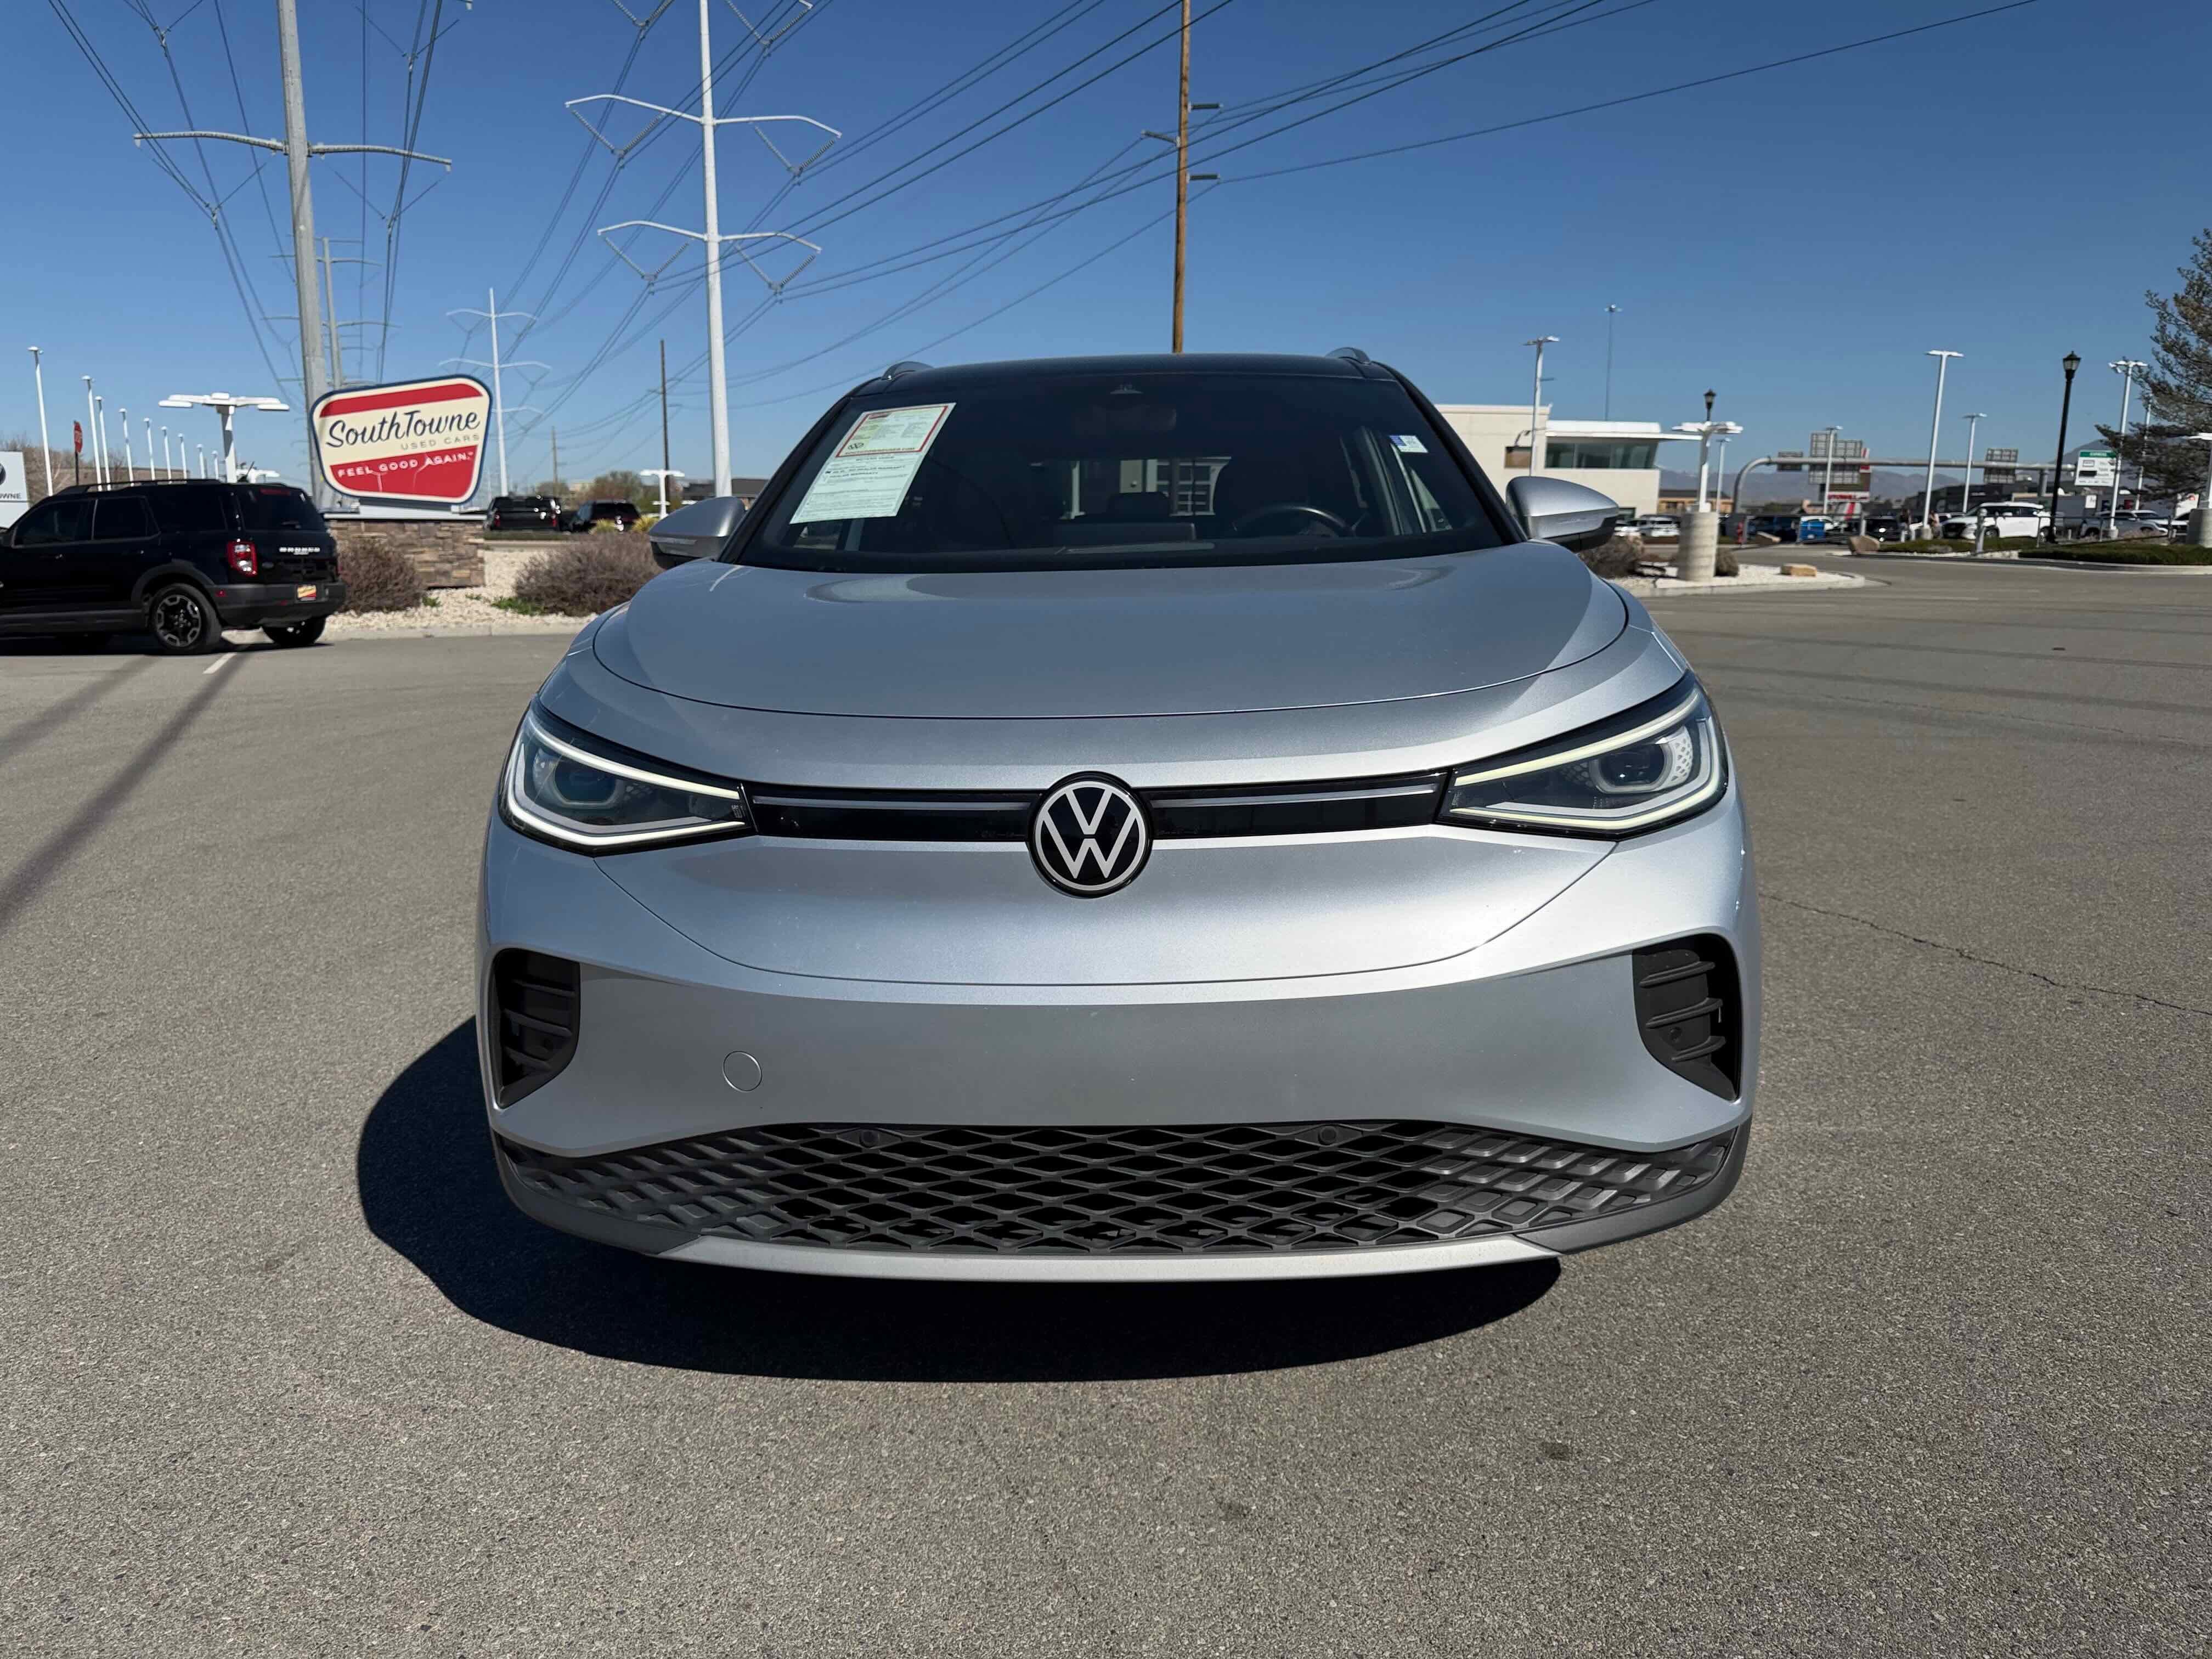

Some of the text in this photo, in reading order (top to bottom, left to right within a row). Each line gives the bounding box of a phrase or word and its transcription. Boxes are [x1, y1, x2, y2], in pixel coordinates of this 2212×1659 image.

[325, 410, 481, 448] SouthTowne
[400, 433, 480, 450] USED CARS
[337, 465, 373, 478] FEEL
[379, 459, 418, 472] GOOD
